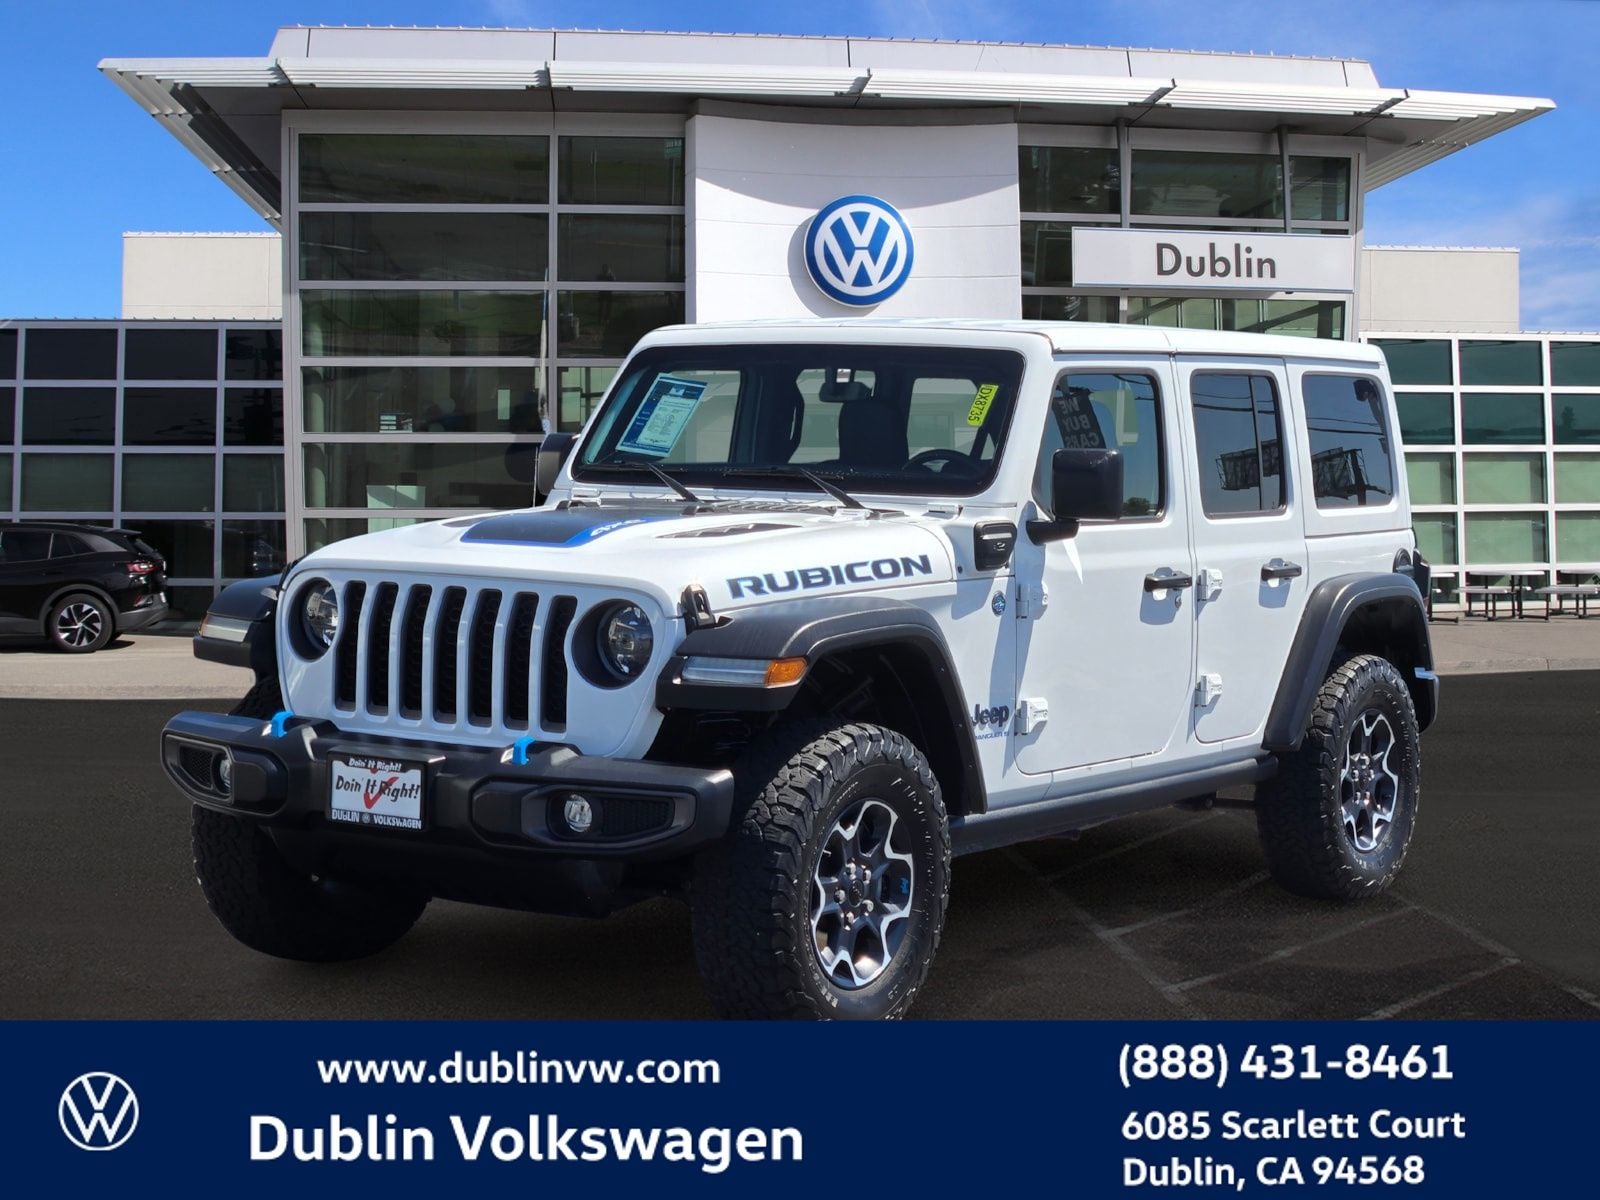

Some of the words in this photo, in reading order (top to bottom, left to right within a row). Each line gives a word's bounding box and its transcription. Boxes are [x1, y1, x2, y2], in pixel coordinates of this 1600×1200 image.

[1156, 242, 1276, 279] Dublin
[968, 387, 993, 422] DX8735
[726, 554, 933, 600] RUBICON
[971, 703, 1010, 727] Jeep
[366, 779, 377, 794] It
[380, 780, 420, 802] Right!
[331, 809, 360, 823] DUBLIN
[373, 814, 422, 829] VOLKSWAGEN
